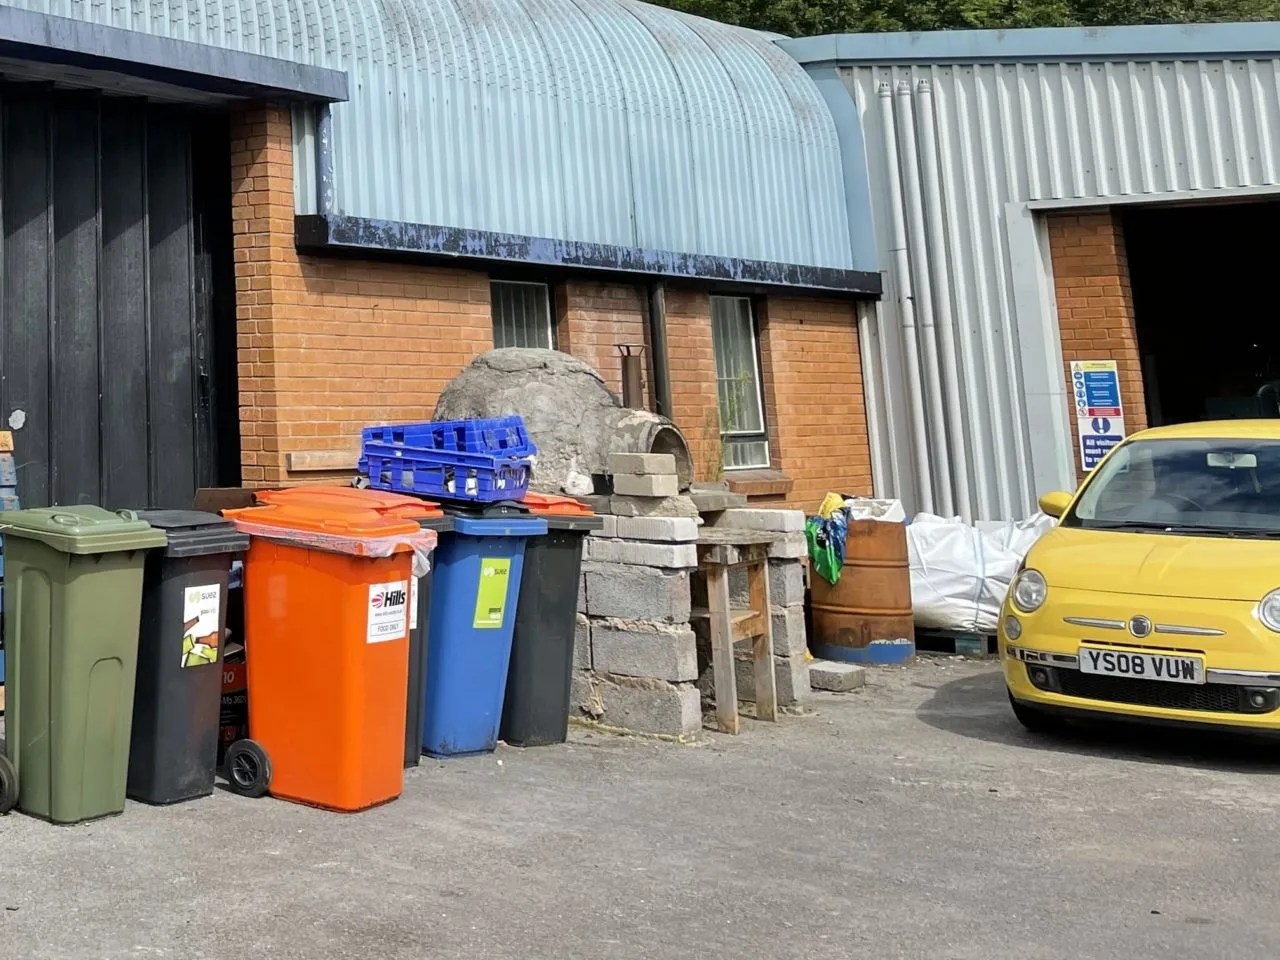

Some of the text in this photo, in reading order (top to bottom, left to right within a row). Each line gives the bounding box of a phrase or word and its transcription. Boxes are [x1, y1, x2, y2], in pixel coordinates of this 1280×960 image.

[384, 589, 406, 607] Hills
[1088, 651, 1195, 680] YS08 VUW
